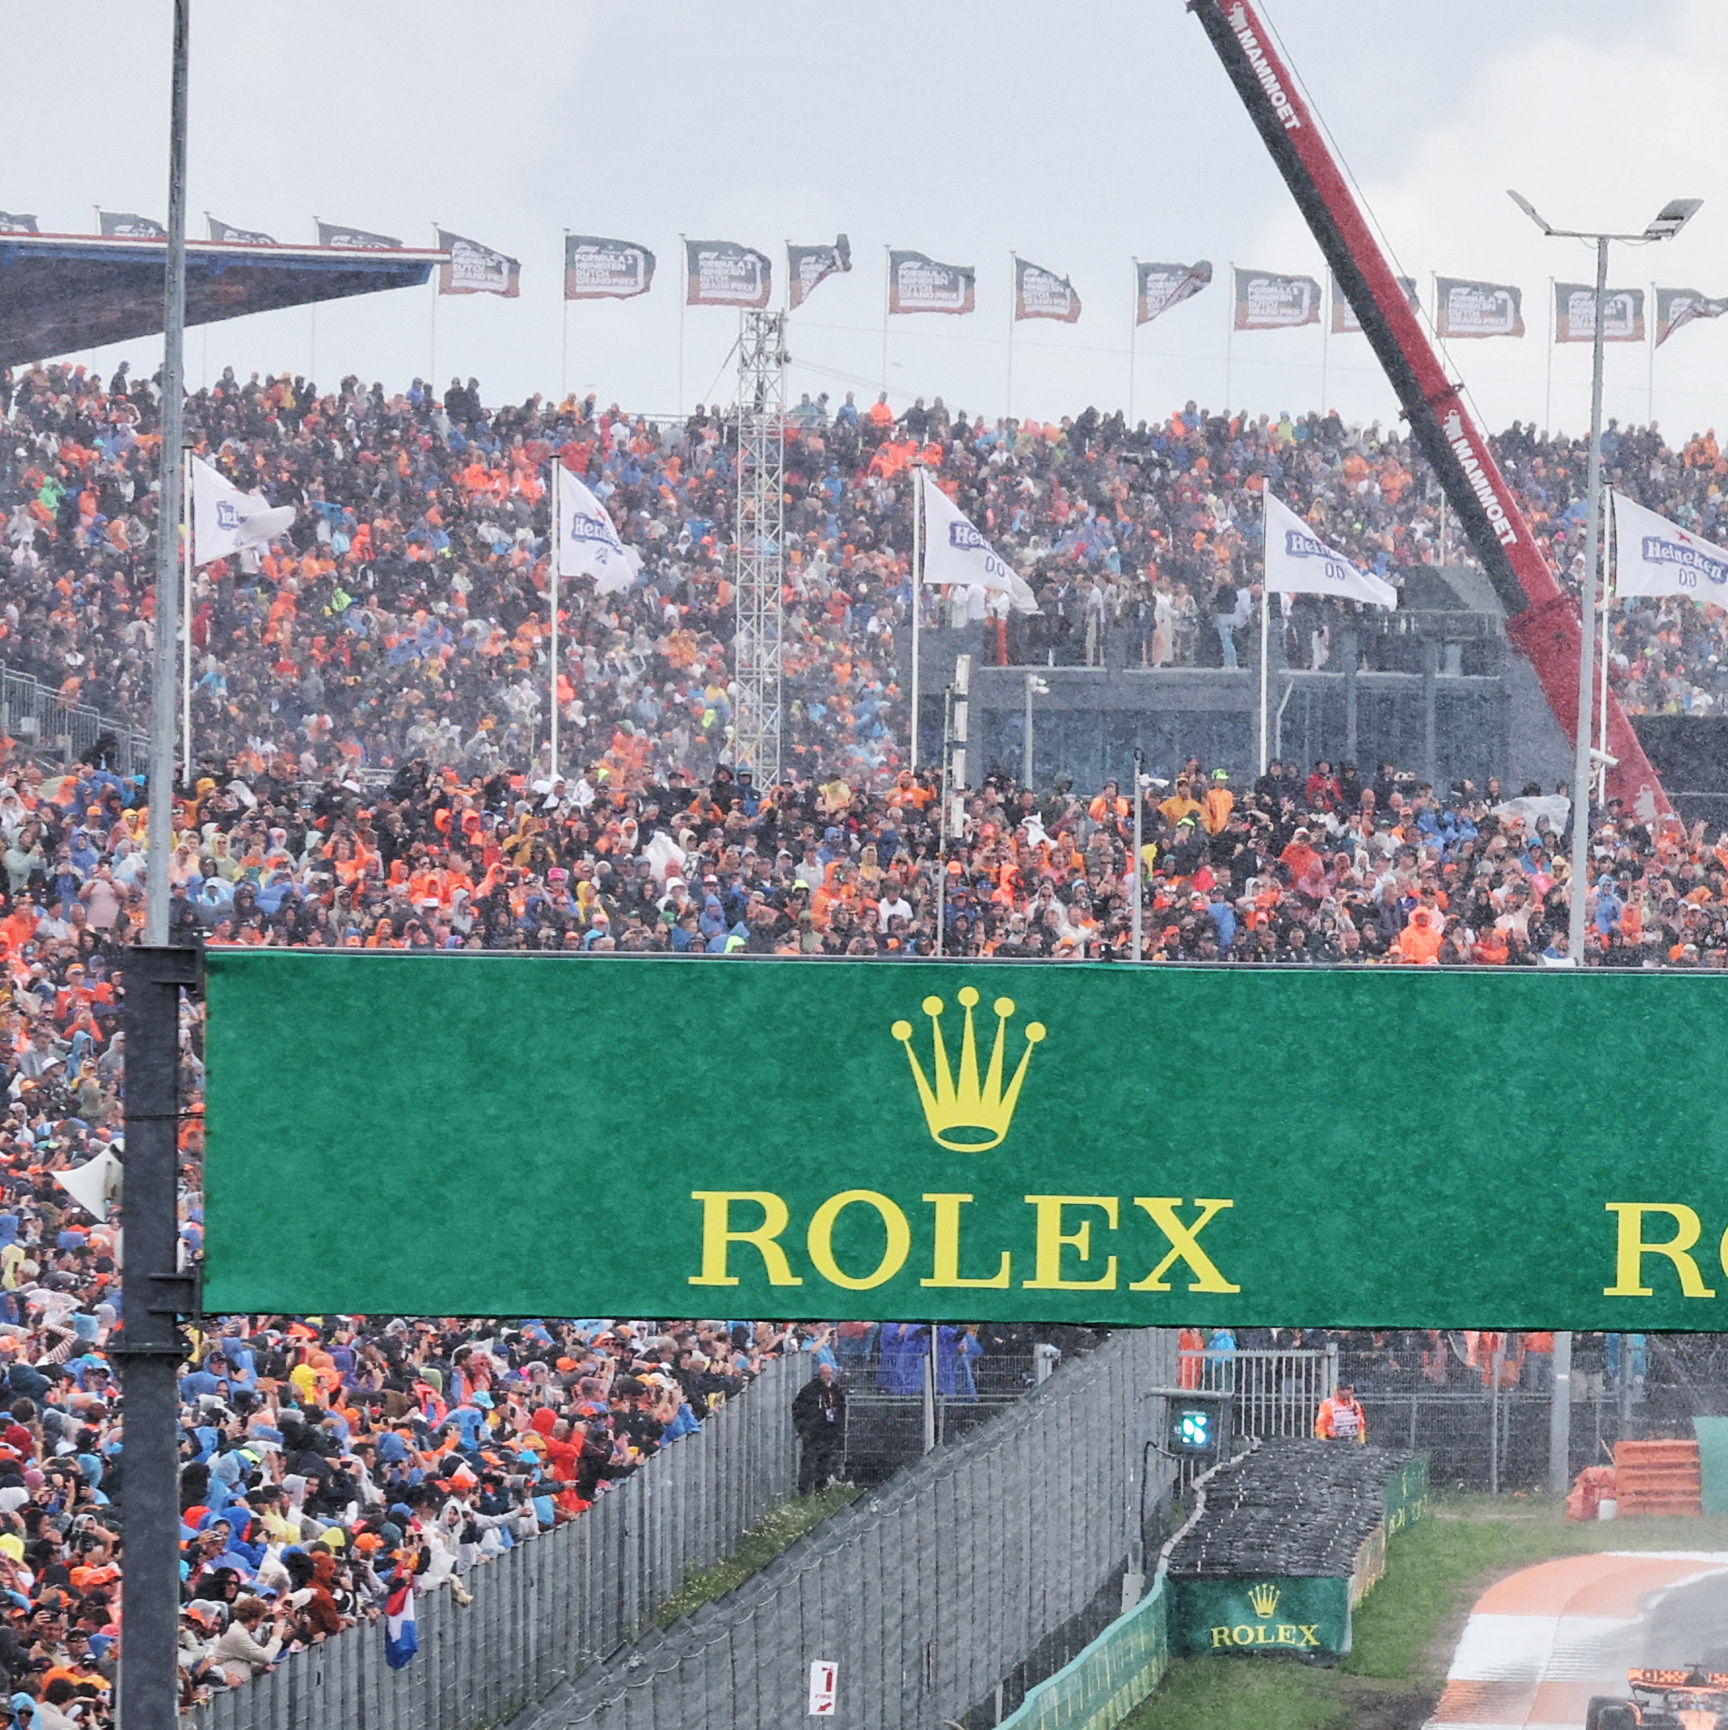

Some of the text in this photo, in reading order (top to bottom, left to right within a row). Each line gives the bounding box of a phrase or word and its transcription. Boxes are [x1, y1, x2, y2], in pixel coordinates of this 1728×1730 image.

[1238, 30, 1300, 132] MAMMOET
[1454, 437, 1517, 547] MAMMOET
[1647, 540, 1725, 579] Heineken
[689, 1190, 1240, 1292] ROLEX
[1211, 1625, 1320, 1648] ROLEX
